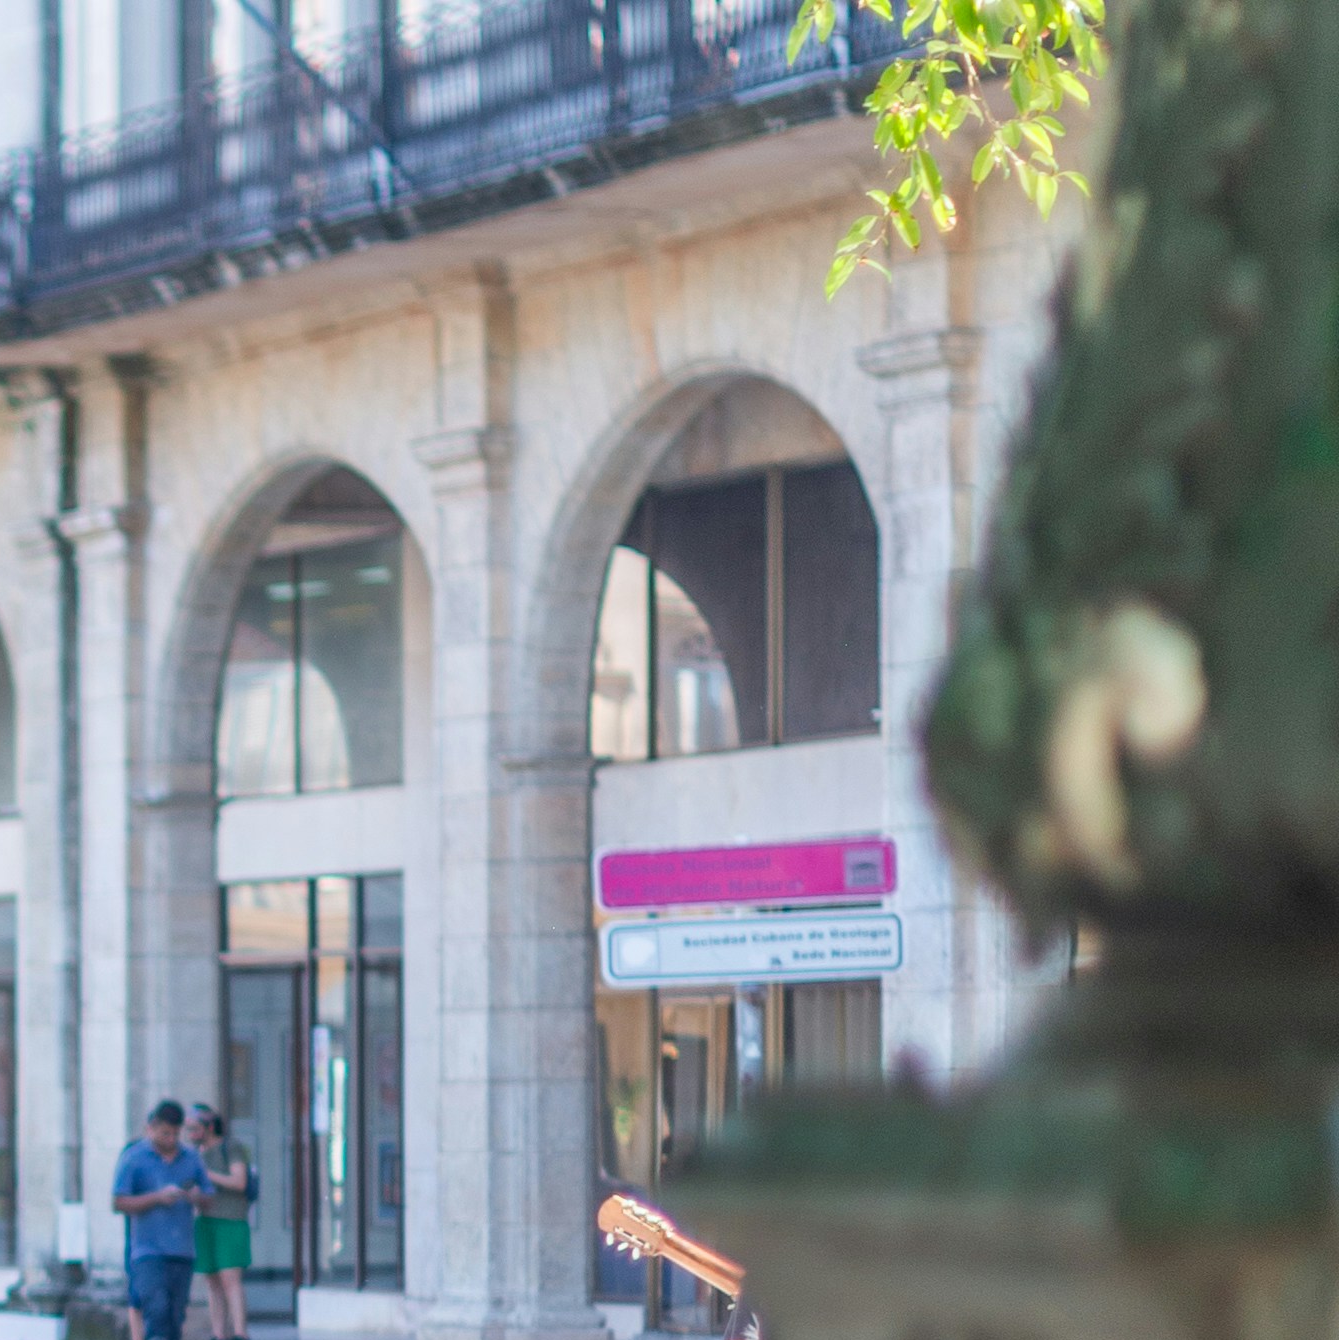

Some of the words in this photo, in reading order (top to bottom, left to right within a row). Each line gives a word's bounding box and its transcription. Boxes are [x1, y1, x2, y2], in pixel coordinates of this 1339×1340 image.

[682, 854, 771, 872] Nacional
[612, 885, 635, 899] de
[642, 880, 721, 897] Historia
[683, 932, 746, 948] Sociedad
[752, 930, 803, 944] Cubana
[808, 928, 824, 941] de
[792, 949, 826, 962] Sede
[831, 945, 892, 960] Nacional
